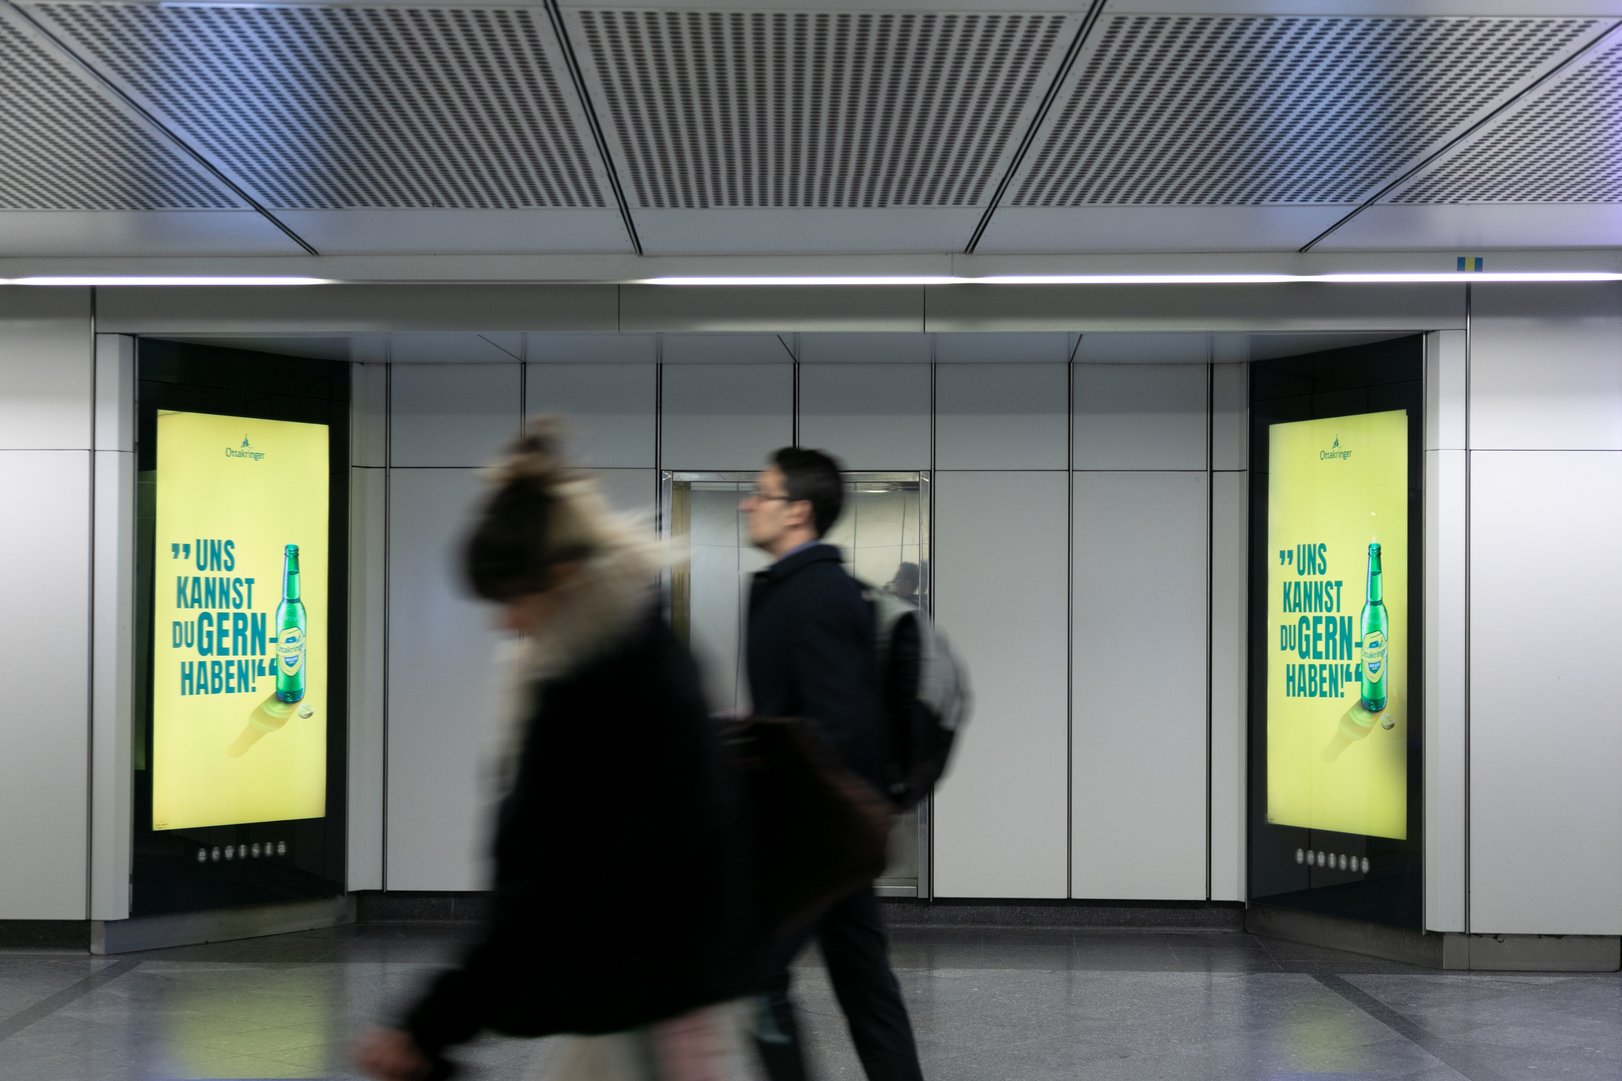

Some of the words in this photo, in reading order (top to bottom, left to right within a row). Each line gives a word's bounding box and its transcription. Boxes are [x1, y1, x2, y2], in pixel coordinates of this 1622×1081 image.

[225, 447, 265, 461] Ottakringer
[176, 576, 255, 610] KANNST
[1283, 580, 1343, 613] KANNST
[172, 620, 195, 648] DU
[1280, 624, 1296, 651] DU
